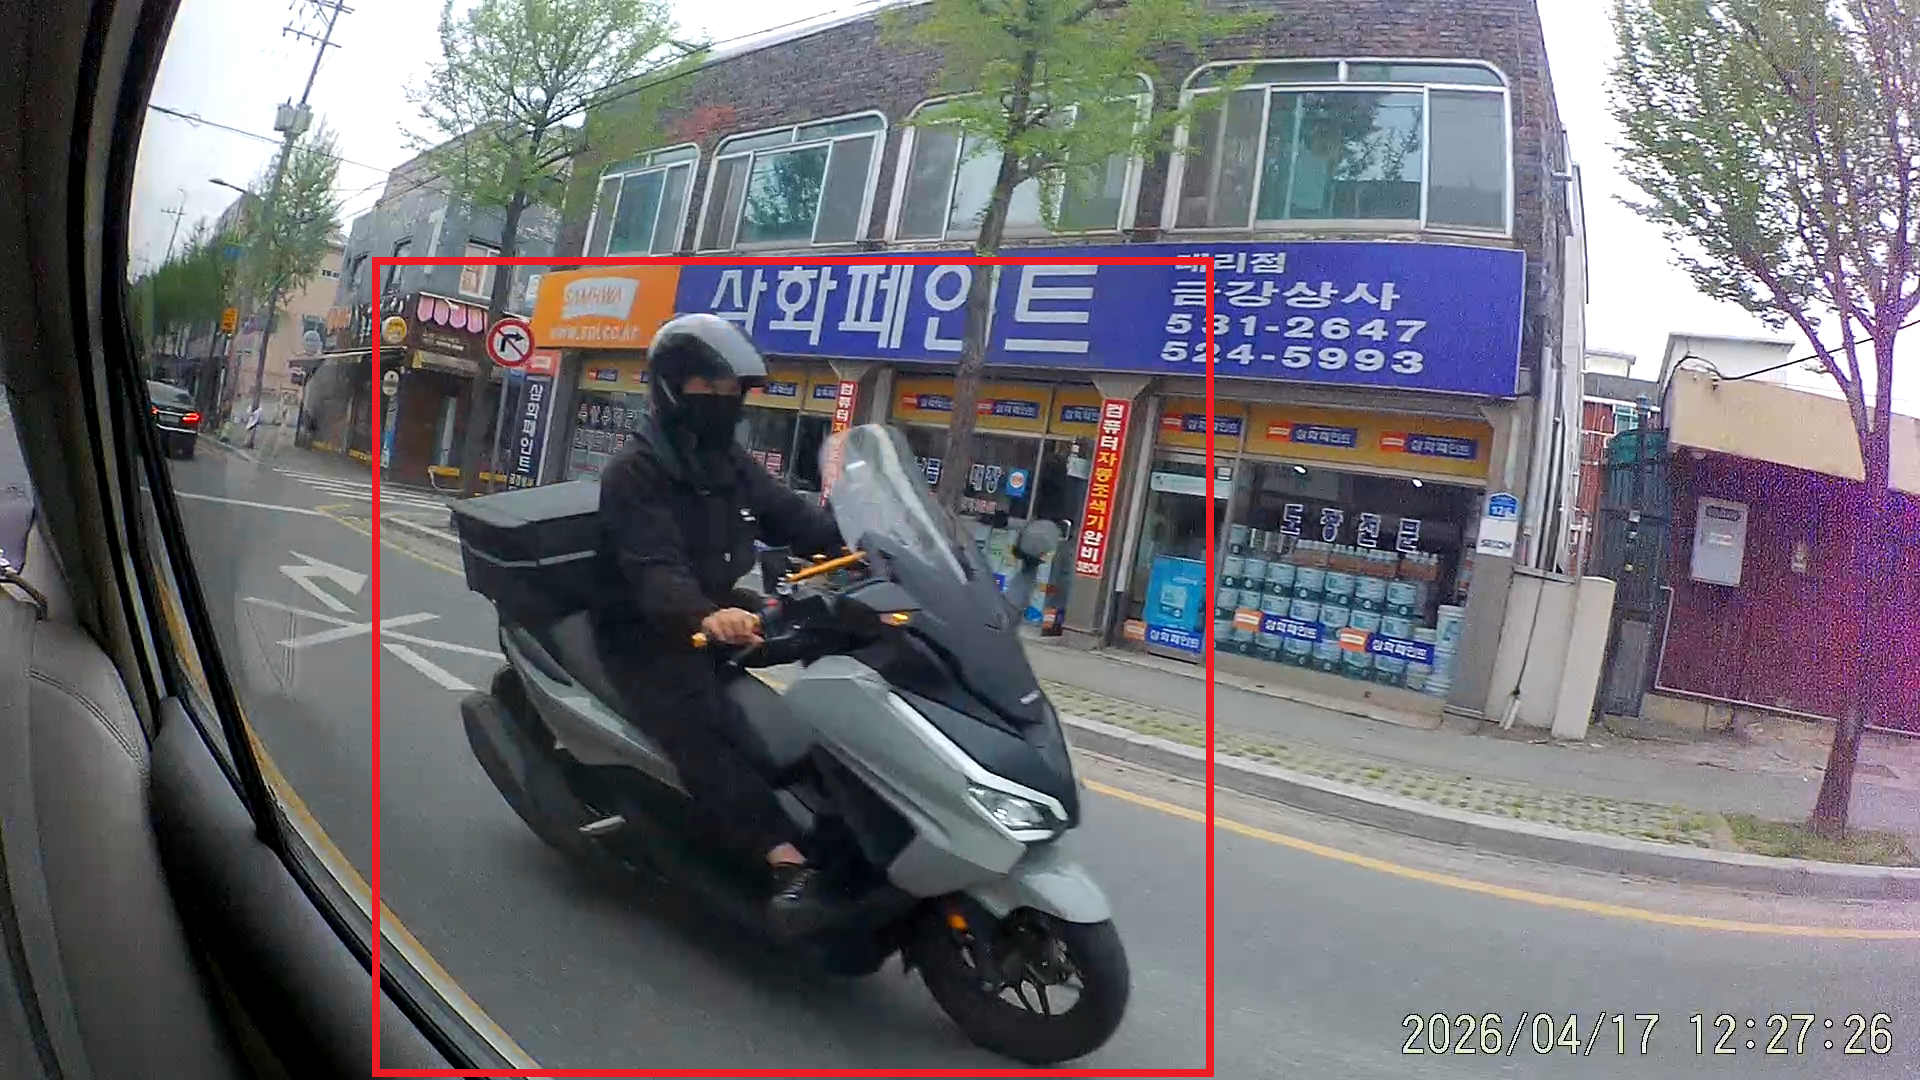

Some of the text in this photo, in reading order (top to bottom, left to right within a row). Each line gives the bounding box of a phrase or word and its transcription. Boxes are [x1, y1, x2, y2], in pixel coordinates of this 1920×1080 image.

[1175, 252, 1287, 274] 대리점
[710, 262, 1098, 353] 삼화페인트
[1170, 280, 1401, 311] 금강상사
[1164, 313, 1427, 343] 531-2647
[1160, 341, 1425, 375] 524-5993
